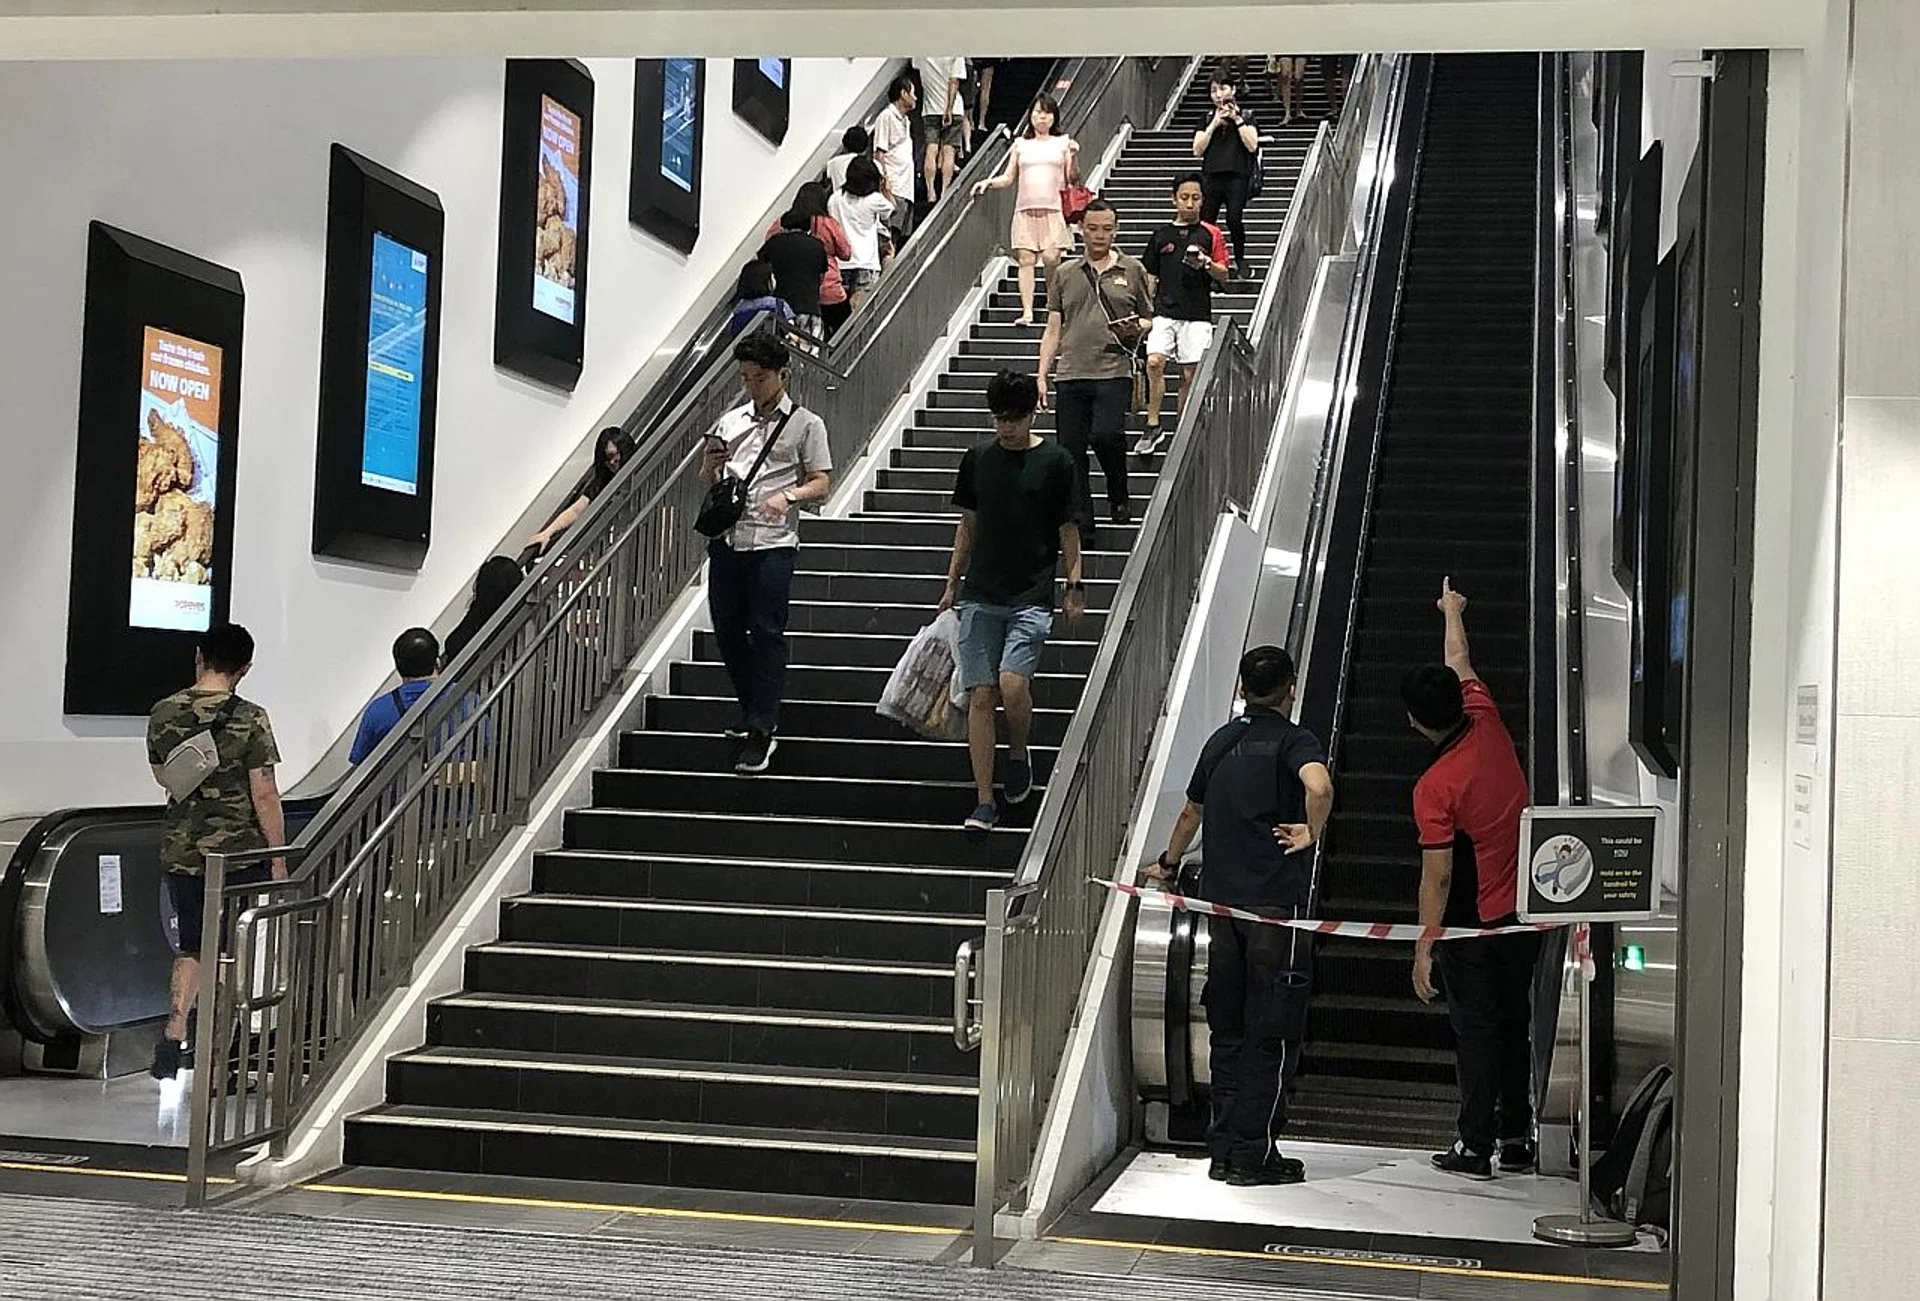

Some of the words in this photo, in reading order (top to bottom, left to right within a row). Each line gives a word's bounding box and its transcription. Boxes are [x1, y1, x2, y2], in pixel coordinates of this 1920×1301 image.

[149, 369, 179, 393] NOW
[179, 377, 210, 401] OPEN
[1603, 880, 1628, 888] handrail
[1618, 892, 1637, 900] safety
